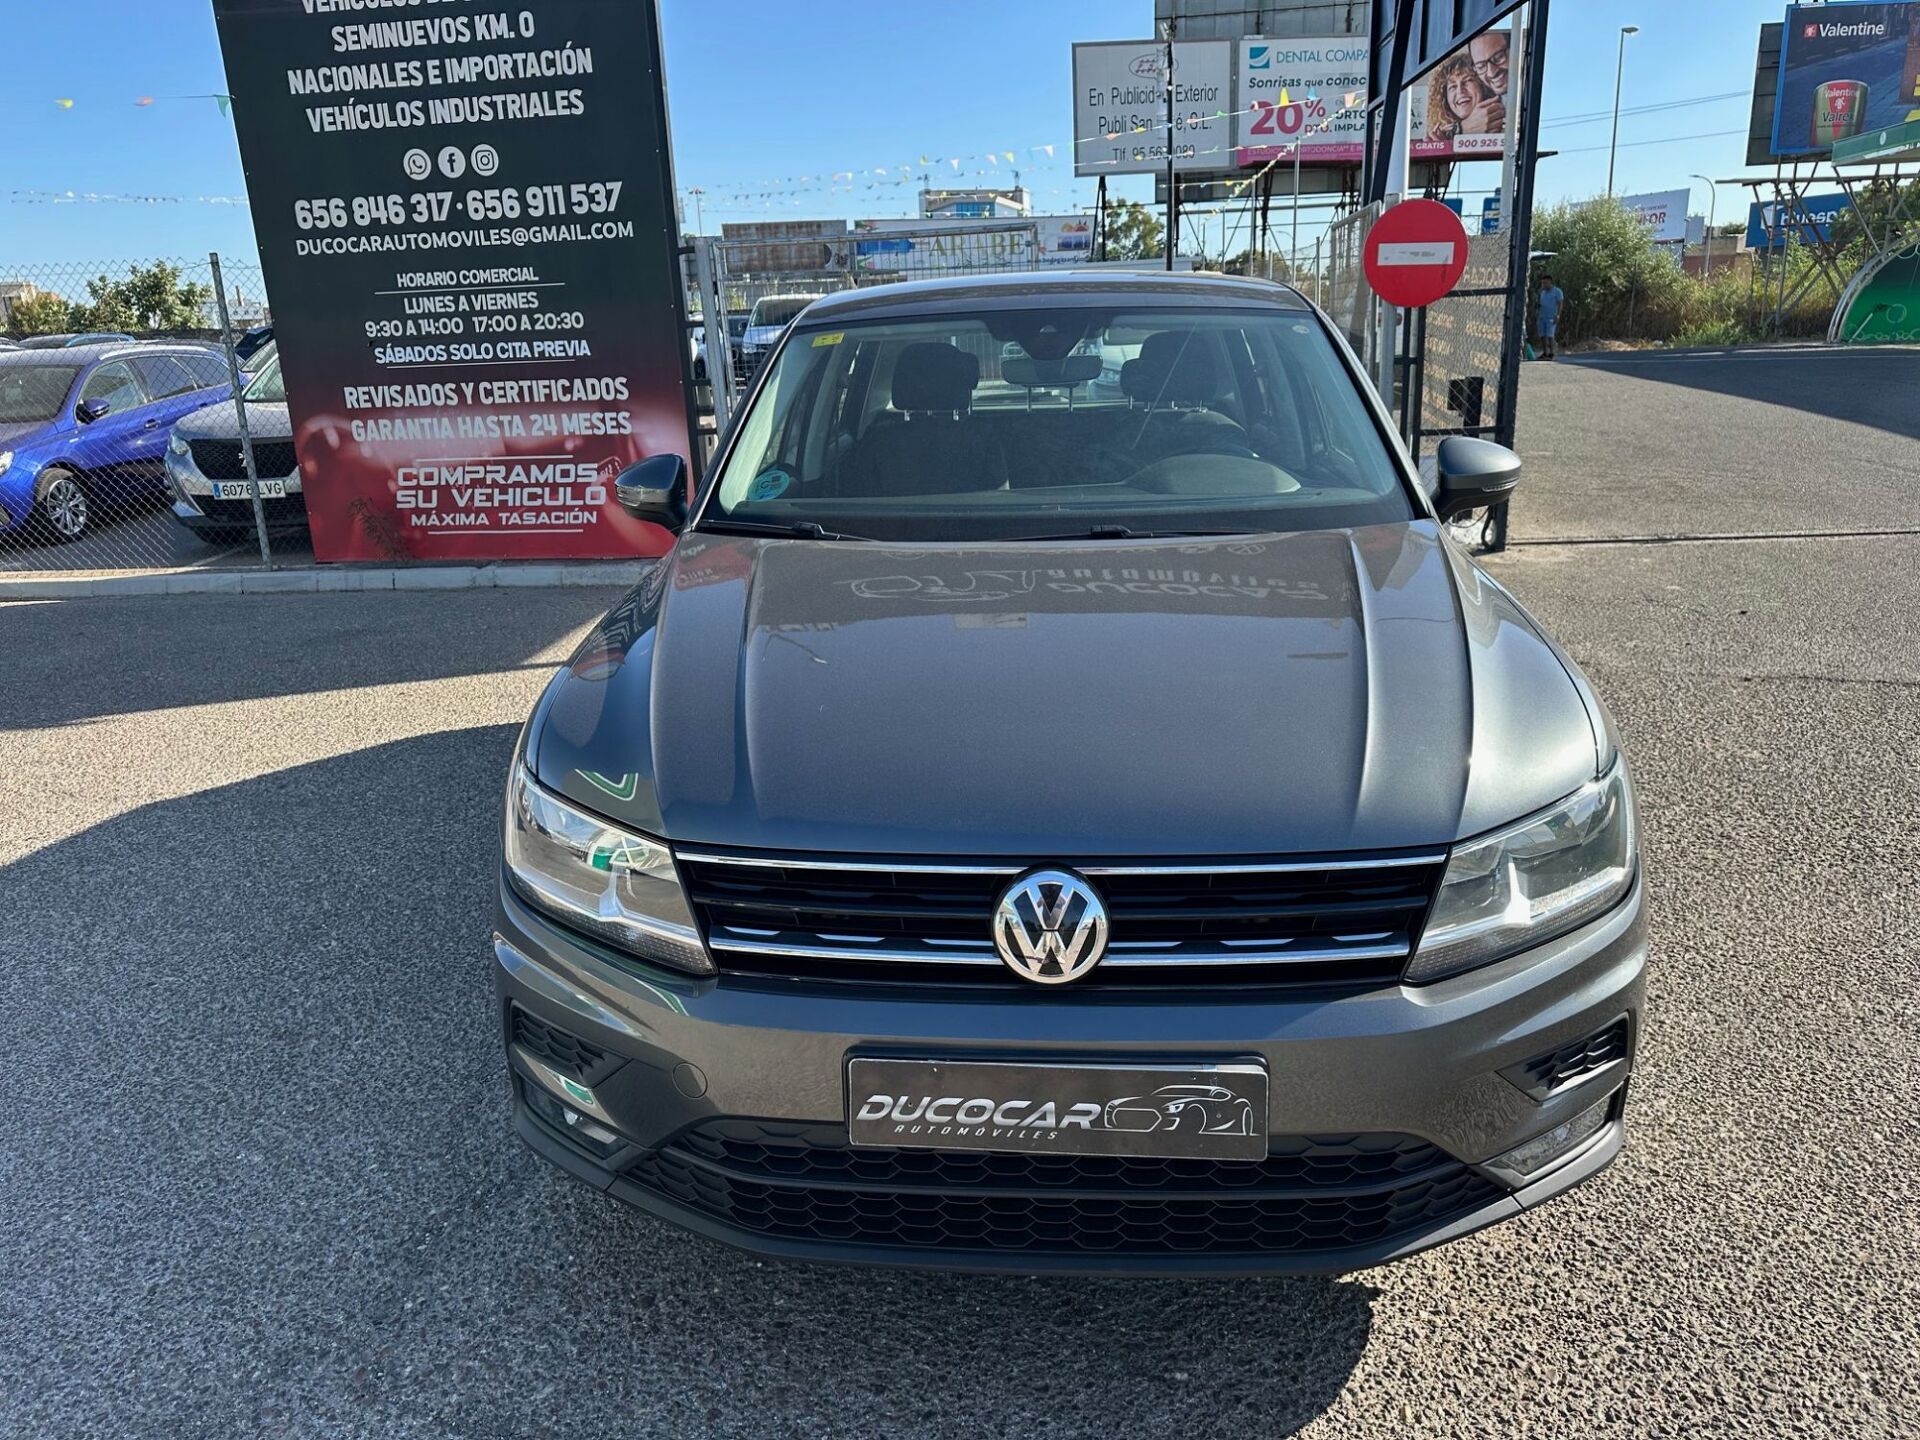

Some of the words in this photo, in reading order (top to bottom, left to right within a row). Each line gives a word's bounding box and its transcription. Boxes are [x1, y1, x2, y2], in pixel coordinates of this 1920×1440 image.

[332, 16, 470, 52] SEMINUEVOS
[474, 13, 515, 40] KM.
[1819, 21, 1885, 37] Valentine
[288, 61, 423, 94] NACIONALES
[427, 60, 442, 84] E
[445, 41, 592, 83] IMPORTACIÓN
[1276, 51, 1322, 63] DENTAL
[1249, 76, 1301, 88] Sonrisas
[1305, 78, 1323, 87] que
[1824, 88, 1859, 99] Valentin
[1089, 88, 1104, 107] En
[1111, 85, 1165, 106] Publicid
[1175, 83, 1219, 103] Exterior
[306, 98, 425, 132] VEHÍCULOS
[428, 89, 584, 124] INDUSTRIALES
[1099, 115, 1127, 134] Publi
[1130, 114, 1153, 132] San
[1415, 142, 1445, 150] GRATIS
[1457, 139, 1478, 148] 900
[1480, 138, 1498, 147] 926
[295, 198, 347, 229] 656
[352, 195, 405, 226] 846
[526, 185, 565, 216] 911
[571, 181, 622, 214] 537
[296, 221, 633, 255] DUCOCARAUTOMOVILES@GMAIL.COM
[397, 271, 457, 287] HORARIO
[459, 267, 539, 284] COMERCIAL
[404, 296, 455, 313] LUNES
[459, 295, 469, 311] A
[471, 292, 538, 310] VIERNES
[365, 320, 402, 337] 9:30
[406, 320, 417, 335] A
[418, 317, 463, 335] 14:00
[472, 315, 517, 332] 17:00
[521, 315, 532, 330] A
[533, 312, 584, 329] 20:30
[375, 343, 447, 363] SÁBADOS
[450, 343, 493, 360] SOLO
[497, 342, 531, 358] CITA
[533, 340, 591, 357] PREVIA
[344, 383, 458, 408] REVISADOS
[460, 383, 474, 405] Y
[479, 377, 628, 404] CERTIFICADOS
[351, 416, 456, 442] GARANTIA
[458, 414, 528, 439] HASTA
[531, 413, 558, 437] 24
[563, 411, 633, 435] MESES
[397, 463, 598, 487] COMPRAMOS
[397, 488, 437, 508] SU
[451, 485, 607, 508] VEHICULO
[412, 510, 489, 526] MÁXIMA
[499, 508, 596, 525] TASACIÓN
[857, 1095, 1102, 1131] DUCOCAR
